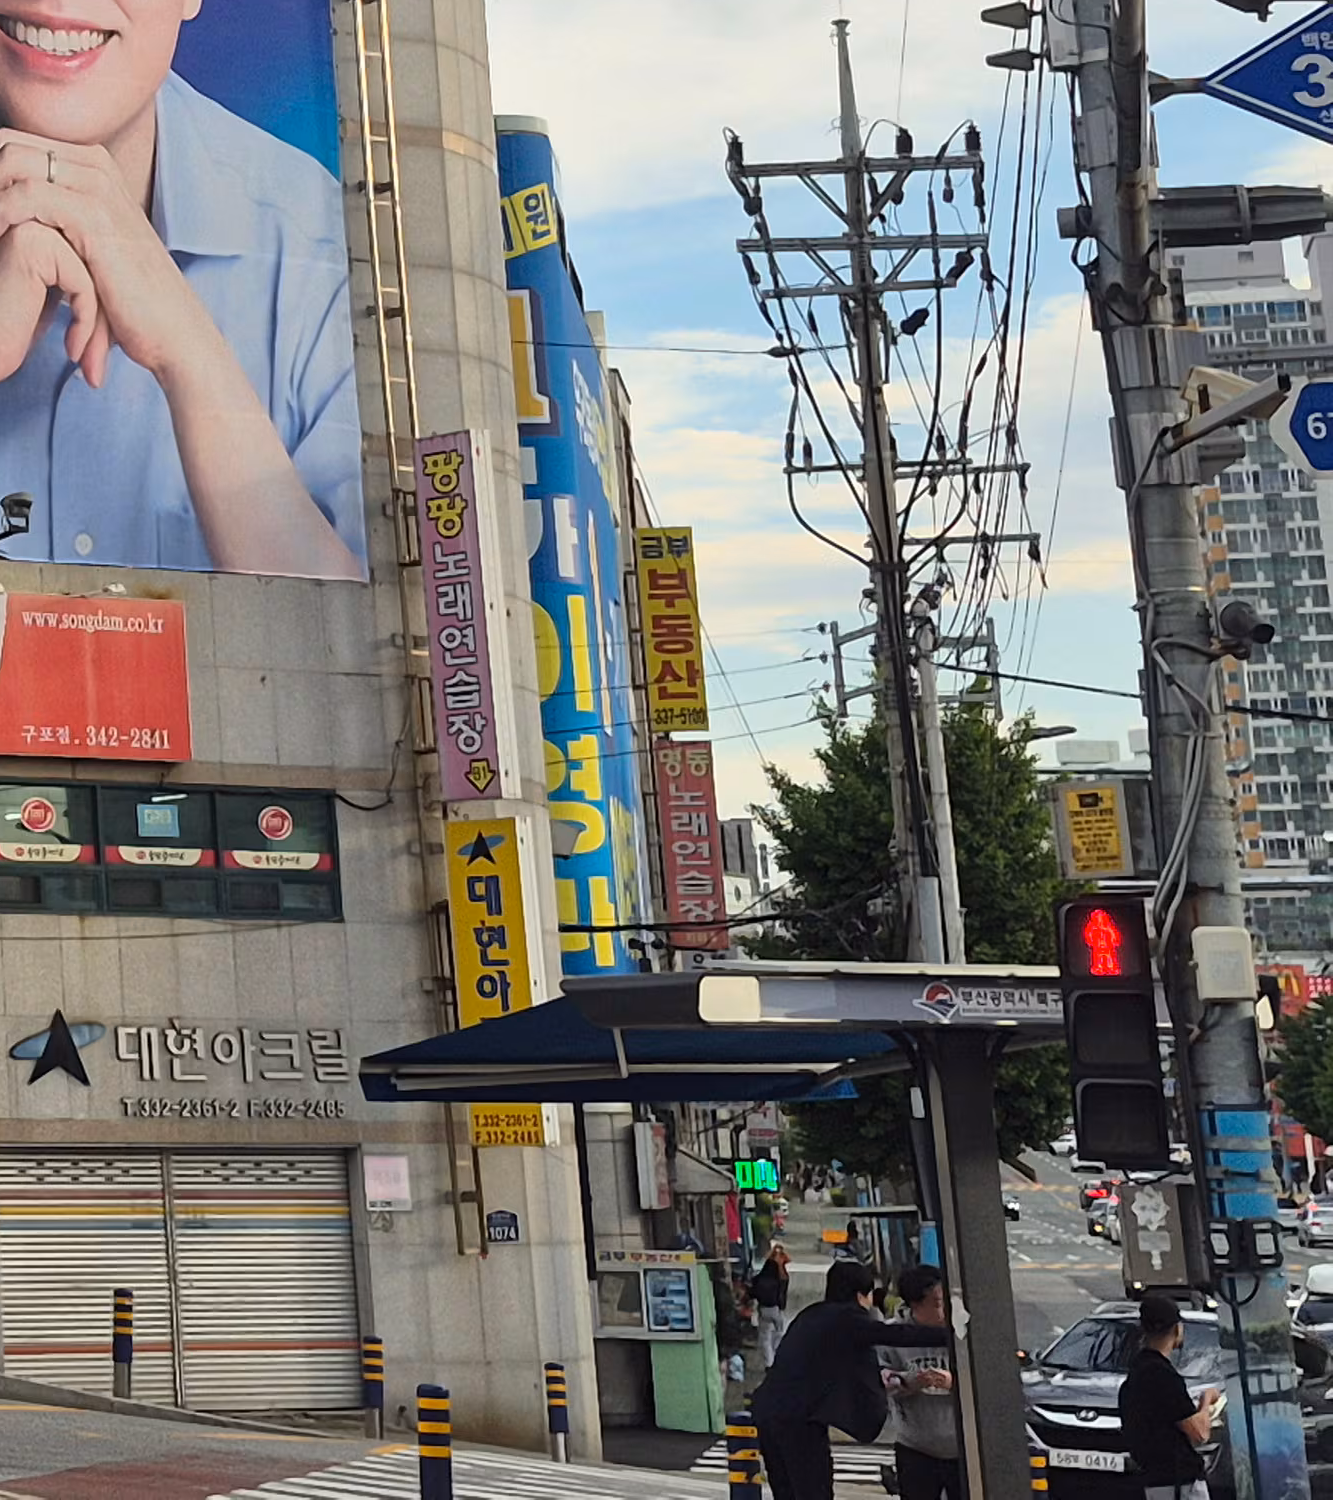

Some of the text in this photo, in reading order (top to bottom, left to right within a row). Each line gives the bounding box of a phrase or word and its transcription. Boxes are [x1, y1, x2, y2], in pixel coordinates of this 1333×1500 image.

[1307, 412, 1333, 440] 6
[21, 608, 164, 634] www.songdam.co.kr
[647, 568, 702, 702] 부동산
[433, 541, 488, 755] 노래연습장
[86, 725, 171, 750] 342-2841
[658, 749, 711, 778] 명동
[668, 782, 720, 924] 노래연습장
[465, 874, 513, 1013] 대현아
[960, 989, 1063, 1008] 부산광역시 북구
[114, 1016, 351, 1084] 대현아크릴
[121, 1097, 241, 1118] T.332-2361-2
